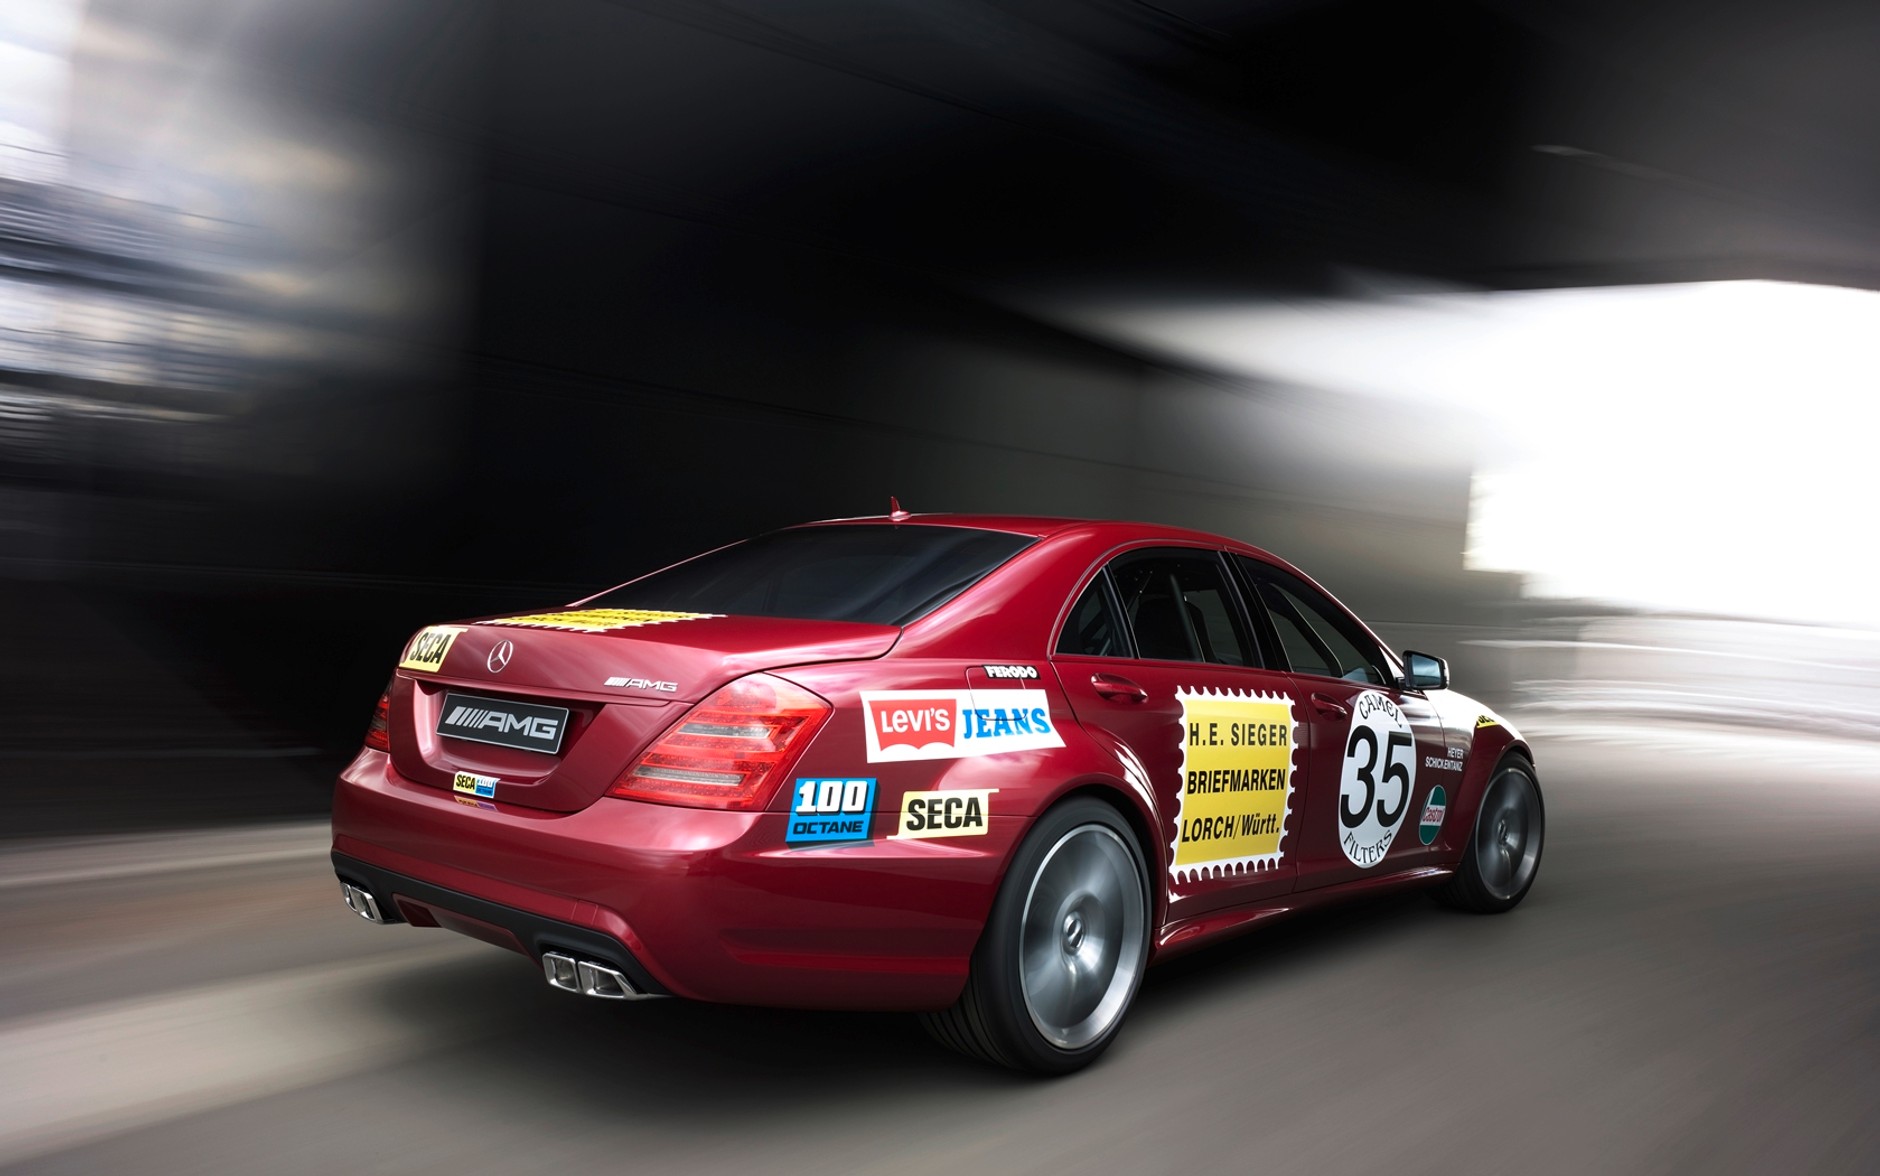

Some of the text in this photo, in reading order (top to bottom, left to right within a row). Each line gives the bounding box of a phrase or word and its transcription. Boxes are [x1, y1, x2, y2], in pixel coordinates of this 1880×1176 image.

[409, 632, 451, 664] SECA
[624, 678, 678, 692] AMG
[984, 665, 1038, 678] FERODO
[479, 710, 557, 740] AMG
[962, 707, 1051, 739] JEANS
[1359, 693, 1402, 728] CAMEL
[1189, 723, 1287, 746] H.E. SIEGER
[456, 774, 475, 790] SECA
[1187, 769, 1286, 795] BRIEFMARKEN
[1340, 725, 1413, 829] 35
[795, 780, 868, 815] 100
[792, 820, 865, 835] OCTANE
[906, 797, 983, 831] SECA
[1181, 812, 1280, 843] LORCH/Württ.
[1343, 829, 1392, 864] FILTERS
